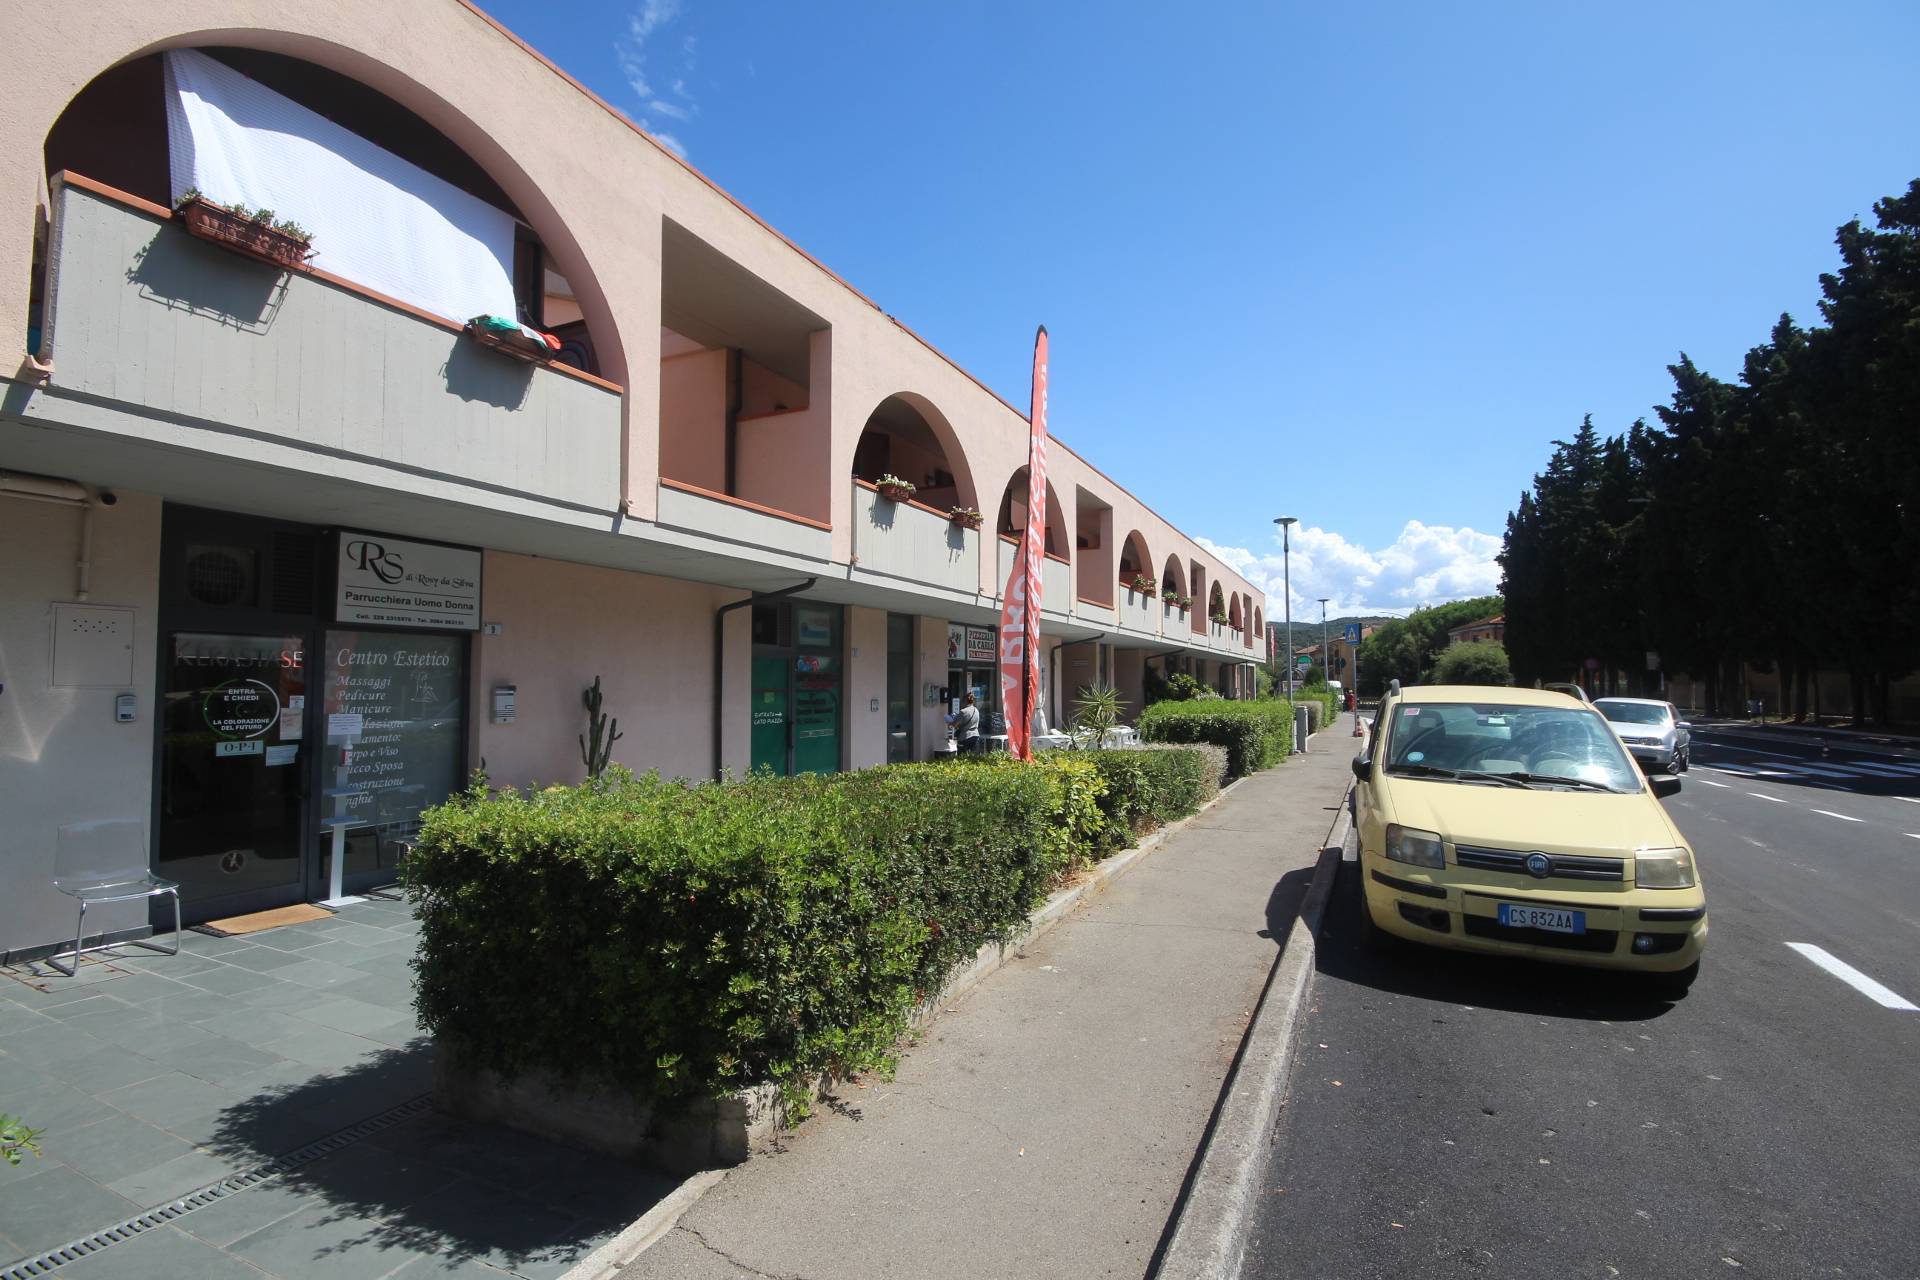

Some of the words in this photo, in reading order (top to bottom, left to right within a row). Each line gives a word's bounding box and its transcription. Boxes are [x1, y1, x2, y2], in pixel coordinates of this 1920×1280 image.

[346, 540, 404, 585] RS
[345, 590, 411, 606] Parrucchiera
[414, 597, 443, 608] Uomo
[445, 600, 474, 610] Donna
[968, 640, 976, 650] DA
[337, 648, 388, 667] Centro
[394, 650, 450, 668] Estetico
[336, 675, 392, 690] Massaggi
[336, 689, 386, 701] Pedicure
[338, 704, 393, 714] Manicure
[223, 718, 270, 726] COLORAZIONE
[377, 746, 399, 757] Viso
[372, 762, 404, 775] Sposa
[1531, 860, 1546, 869] FIAT
[1511, 908, 1527, 924] CS
[1530, 911, 1572, 929] 832AA
